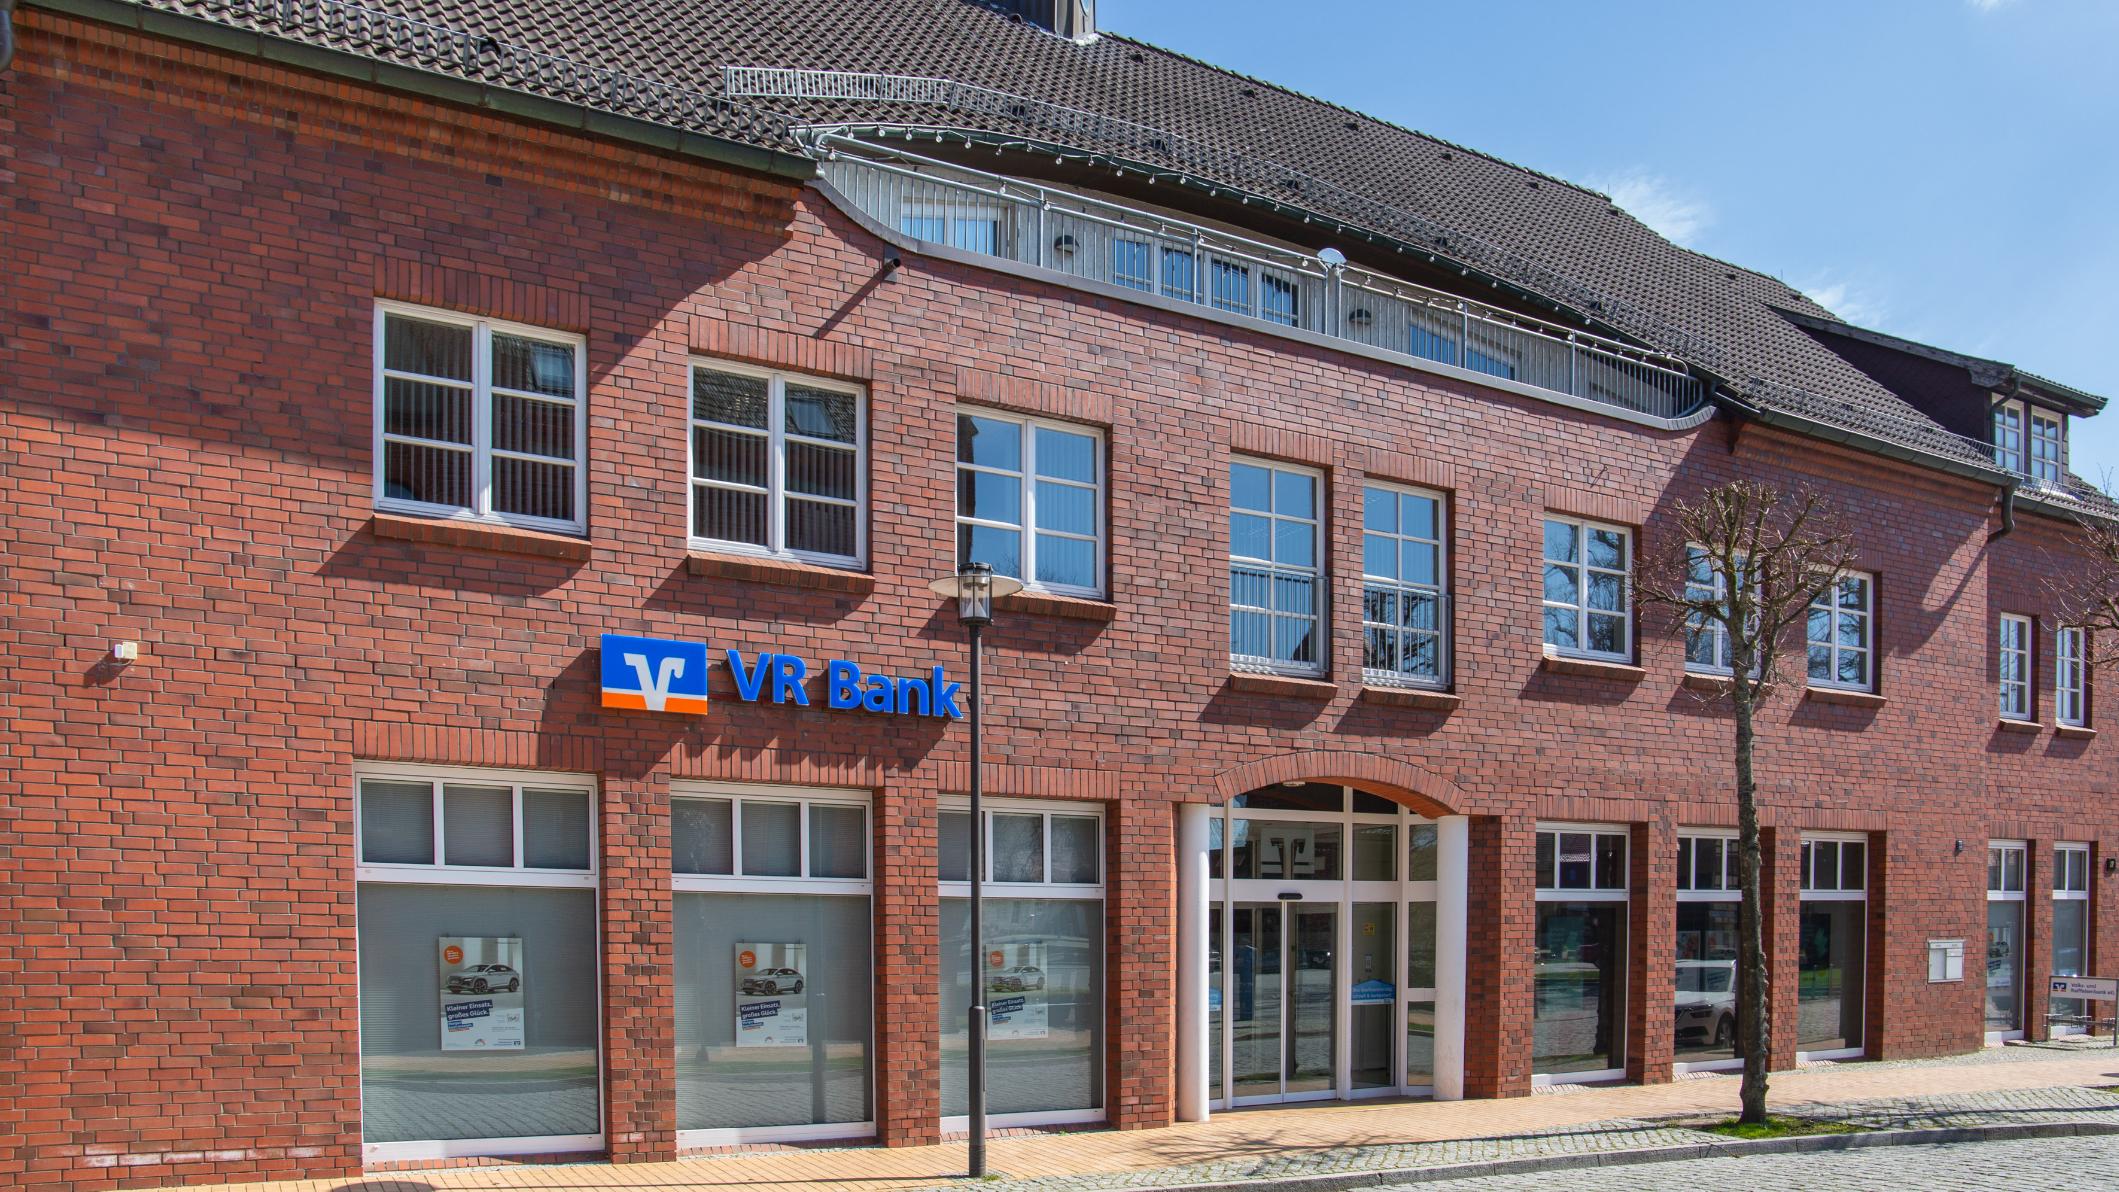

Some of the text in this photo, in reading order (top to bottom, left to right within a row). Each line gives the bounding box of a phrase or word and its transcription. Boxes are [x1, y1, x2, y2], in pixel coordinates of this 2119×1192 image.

[725, 649, 964, 719] VR Bank
[446, 1004, 468, 1012] Kleiner
[447, 1011, 469, 1021] großes
